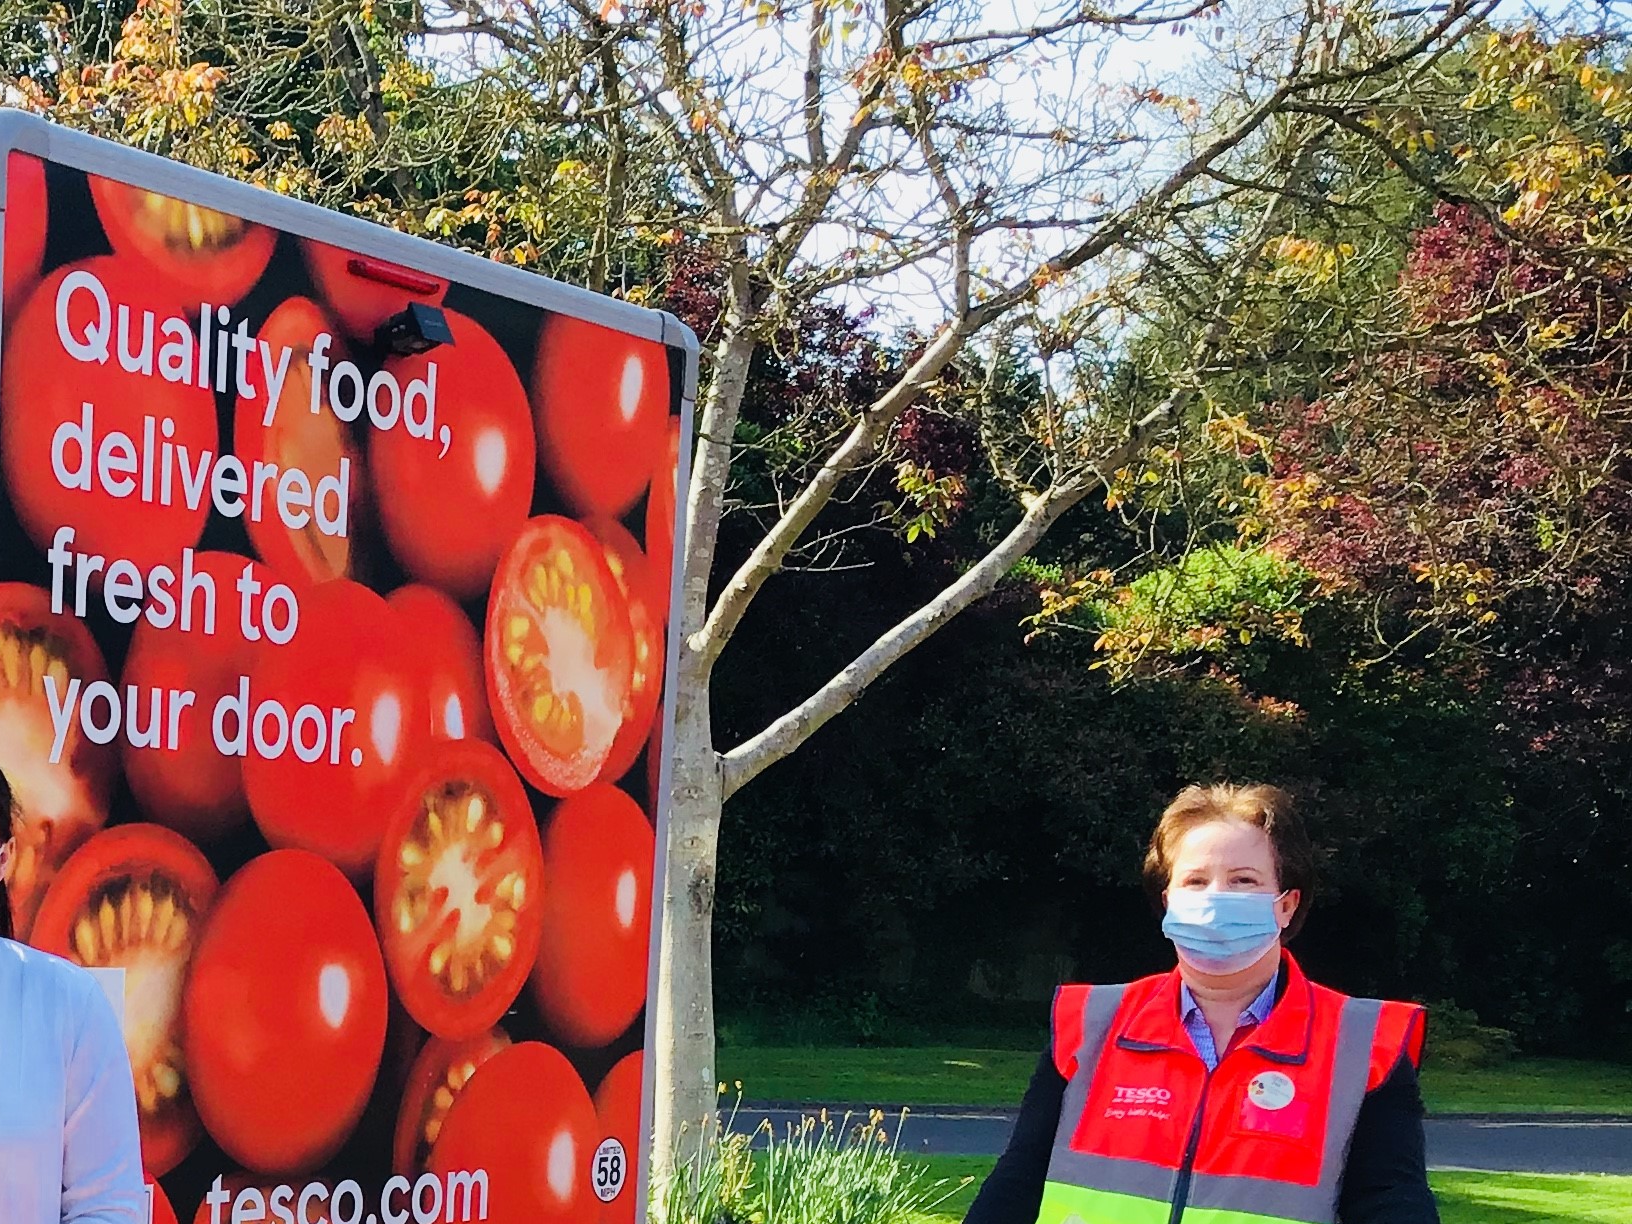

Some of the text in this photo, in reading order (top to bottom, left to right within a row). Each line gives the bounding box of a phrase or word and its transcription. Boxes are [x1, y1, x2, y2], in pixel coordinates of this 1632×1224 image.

[56, 271, 453, 458] Quality food,
[52, 402, 350, 537] delivered
[48, 527, 299, 645] fresh to
[44, 675, 364, 766] your door.
[1114, 1086, 1171, 1101] TESCO
[597, 1155, 621, 1187] 58
